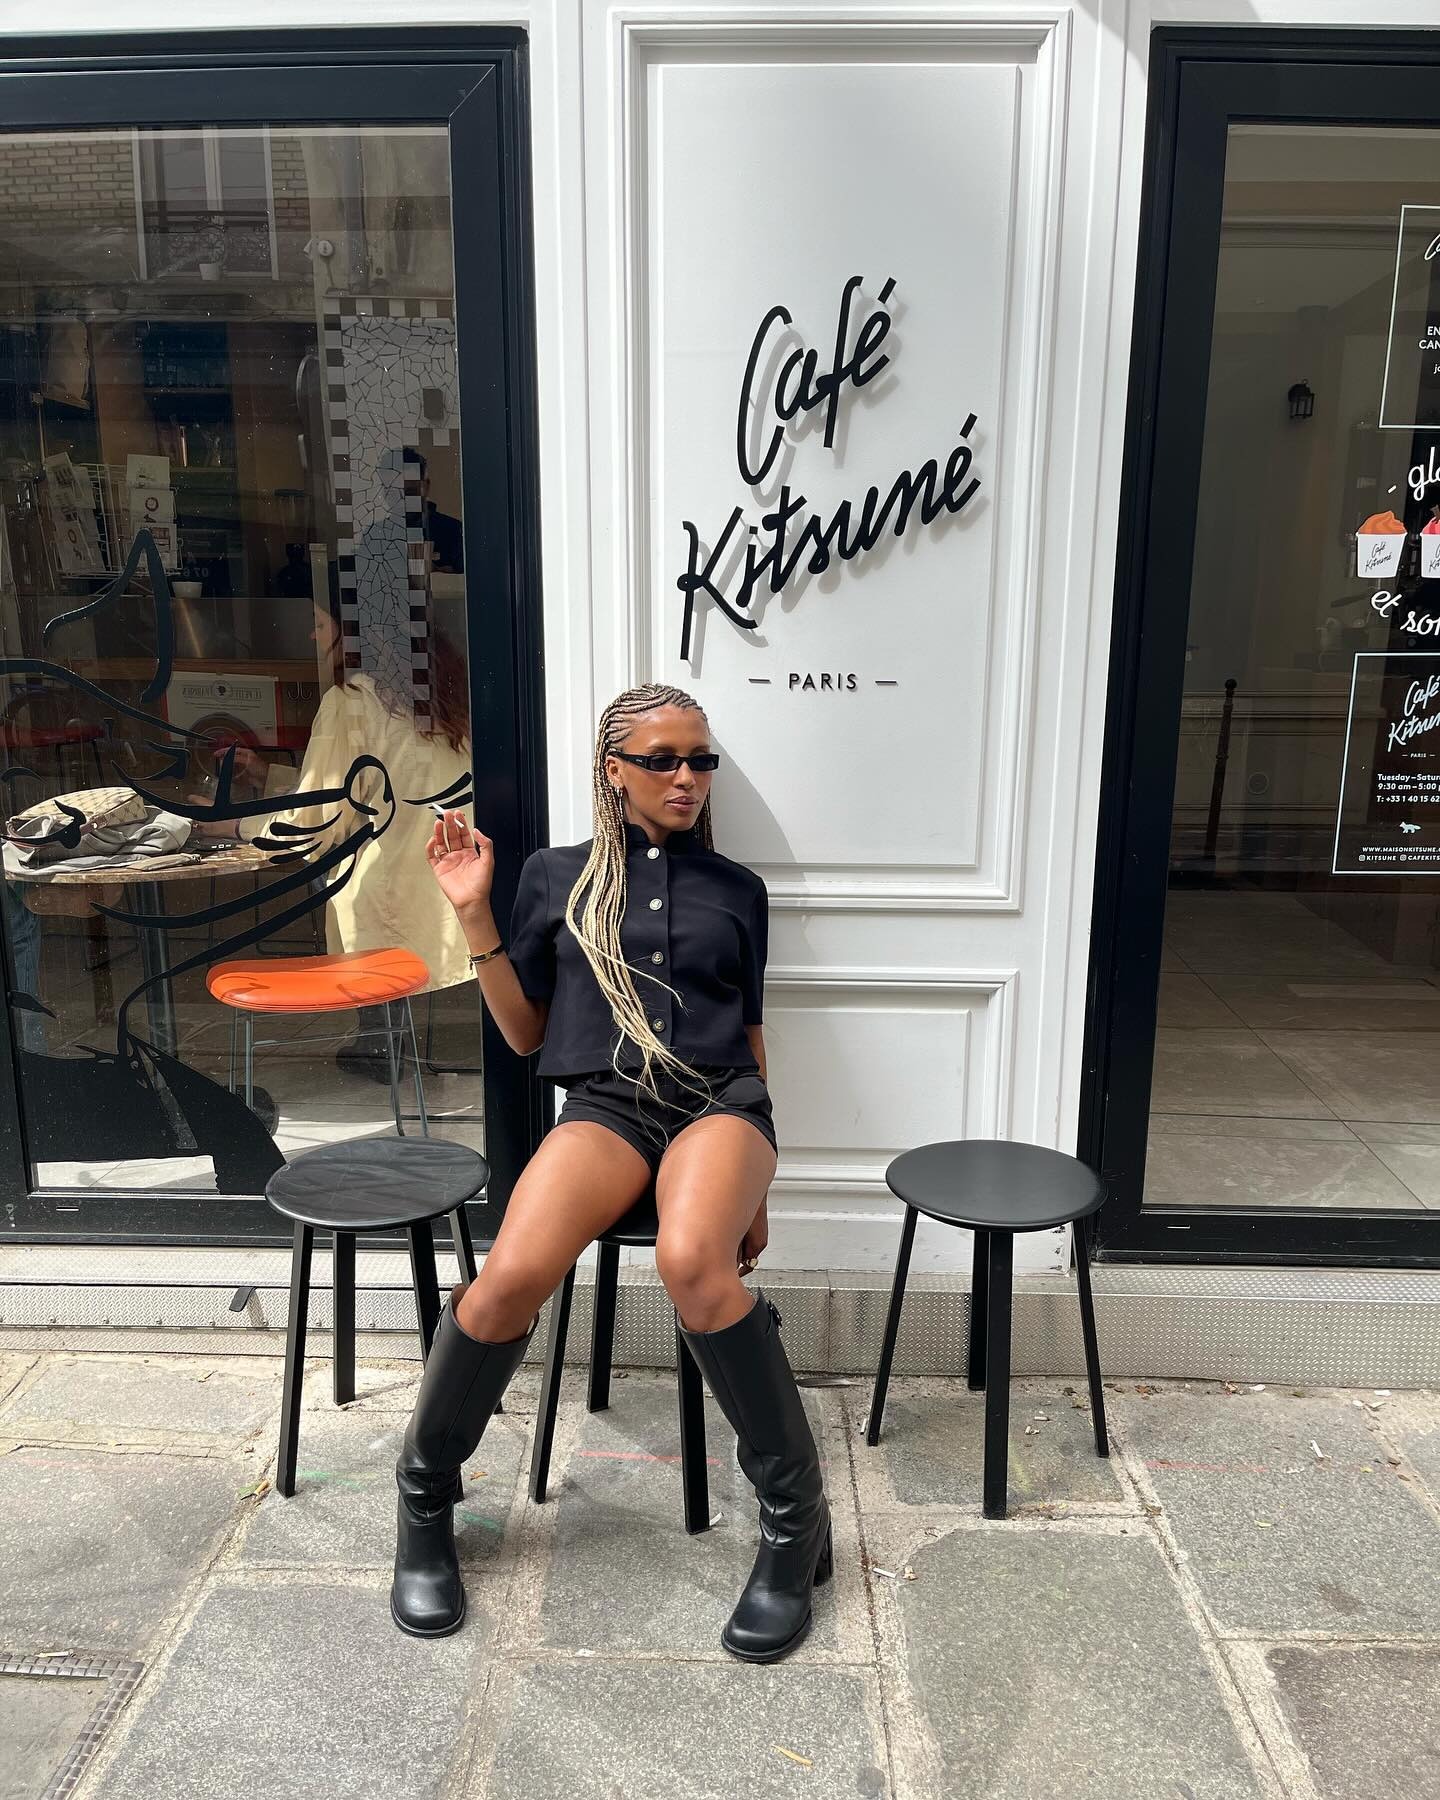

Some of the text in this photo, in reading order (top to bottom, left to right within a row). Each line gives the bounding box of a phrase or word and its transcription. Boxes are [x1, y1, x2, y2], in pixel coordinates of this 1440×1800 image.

[737, 276, 896, 486] Café
[677, 413, 981, 660] Kitsuné
[1370, 590, 1402, 618] et
[789, 673, 857, 689] PARIS
[1404, 675, 1440, 717] Café
[1376, 795, 1385, 803] T:
[1386, 795, 1401, 803] +33
[1408, 795, 1419, 803] 40
[1420, 795, 1429, 803] 15
[1430, 795, 1440, 803] 62
